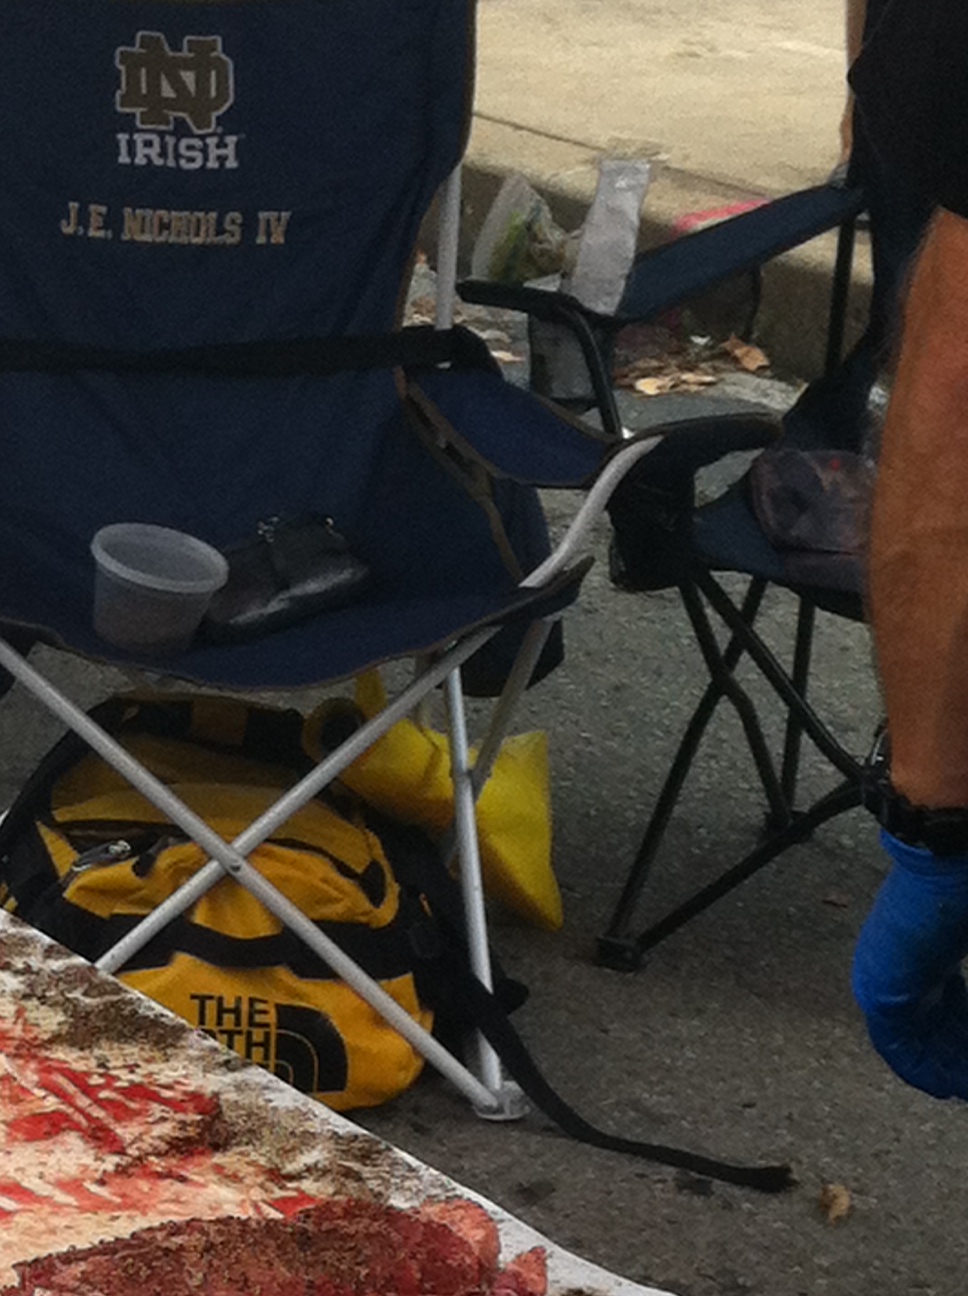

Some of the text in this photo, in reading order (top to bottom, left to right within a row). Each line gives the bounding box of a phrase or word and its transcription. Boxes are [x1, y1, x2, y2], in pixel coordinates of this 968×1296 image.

[116, 133, 239, 169] IRISH
[121, 207, 244, 245] NICHOLS
[255, 211, 292, 244] IV
[189, 994, 271, 1028] THE
